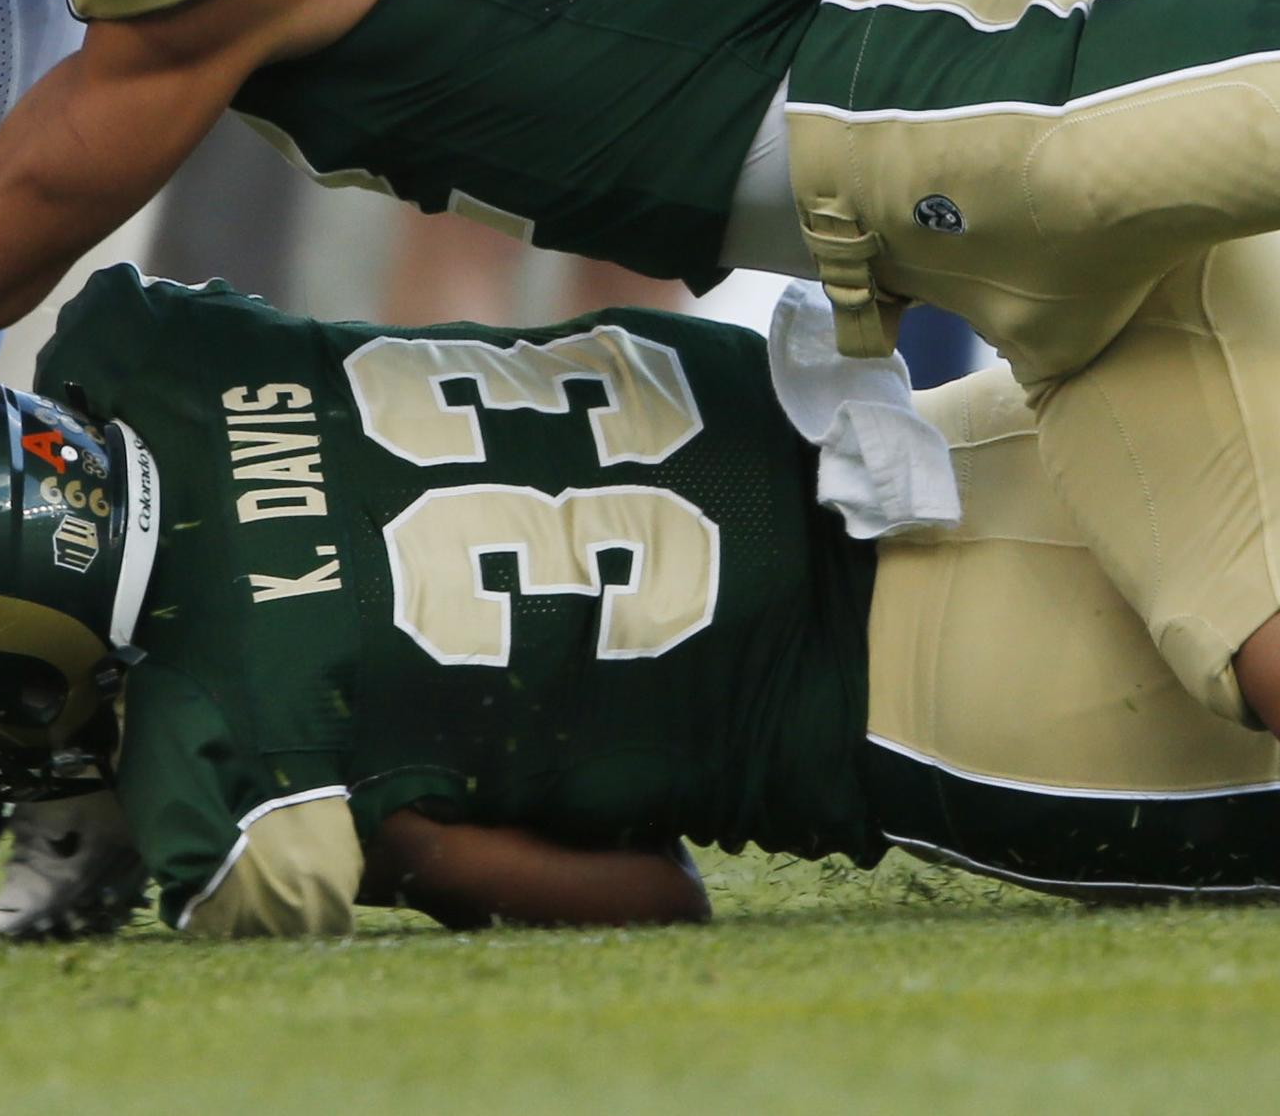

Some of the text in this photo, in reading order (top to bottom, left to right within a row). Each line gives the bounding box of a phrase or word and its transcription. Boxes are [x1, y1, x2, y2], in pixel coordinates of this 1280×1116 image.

[21, 429, 66, 474] A
[138, 453, 152, 533] Colorado
[221, 383, 342, 604] K. DAVIS
[342, 325, 721, 668] 33
